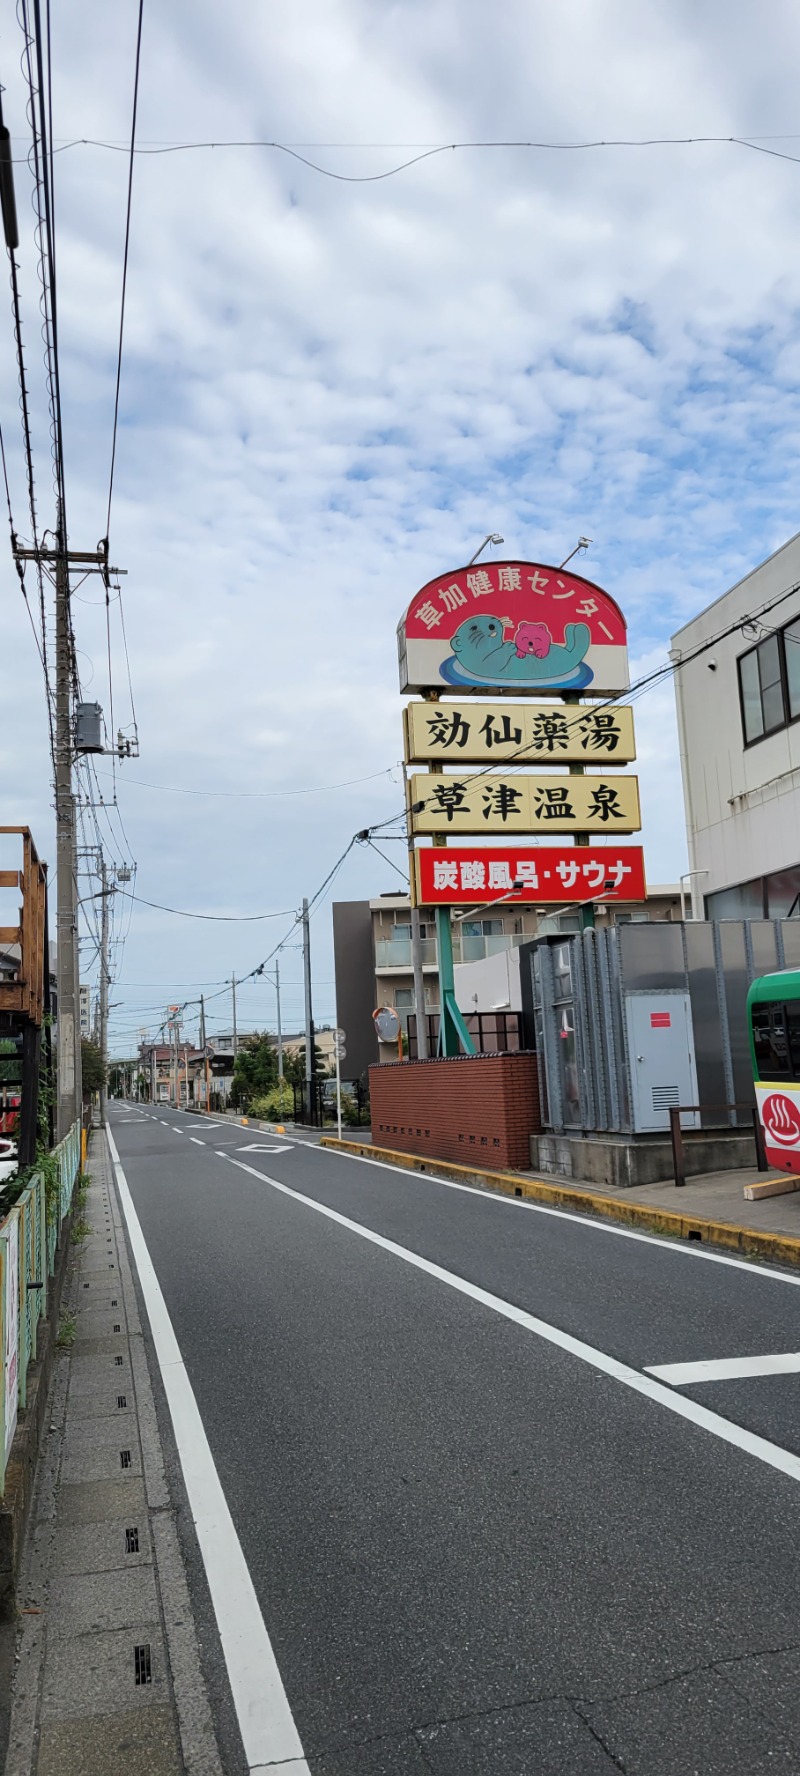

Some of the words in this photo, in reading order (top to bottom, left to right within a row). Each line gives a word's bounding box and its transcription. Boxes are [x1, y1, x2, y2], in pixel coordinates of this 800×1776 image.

[414, 566, 614, 641] 草加健康センター
[426, 711, 621, 752] 効仙薬湯
[430, 782, 627, 822] 草津温泉
[433, 860, 632, 890] 炭酸風呂・サウナ
